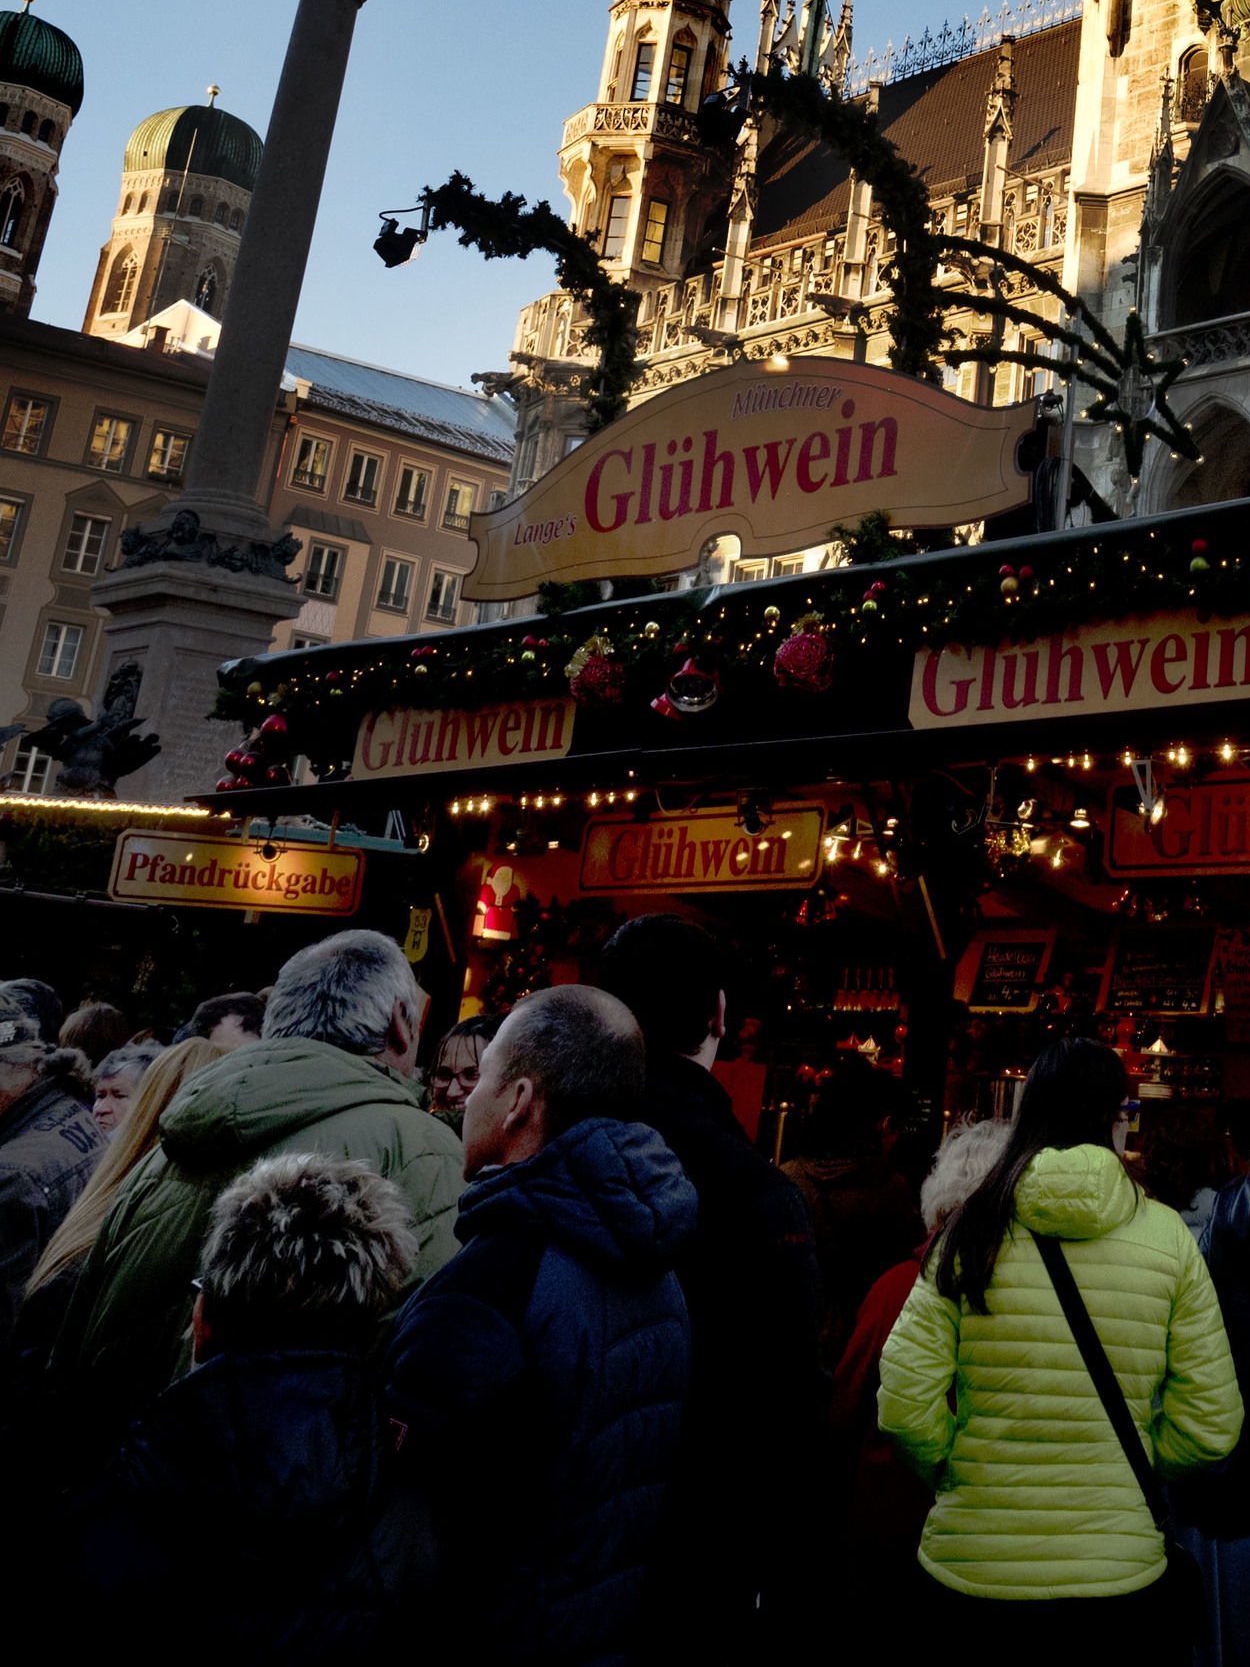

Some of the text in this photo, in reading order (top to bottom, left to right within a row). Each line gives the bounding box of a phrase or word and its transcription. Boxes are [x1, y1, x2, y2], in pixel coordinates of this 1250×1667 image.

[731, 382, 843, 419] Münchner
[583, 398, 899, 534] Glühwein
[124, 851, 354, 901] Pfandrückgabe
[608, 825, 788, 882] Glühwein
